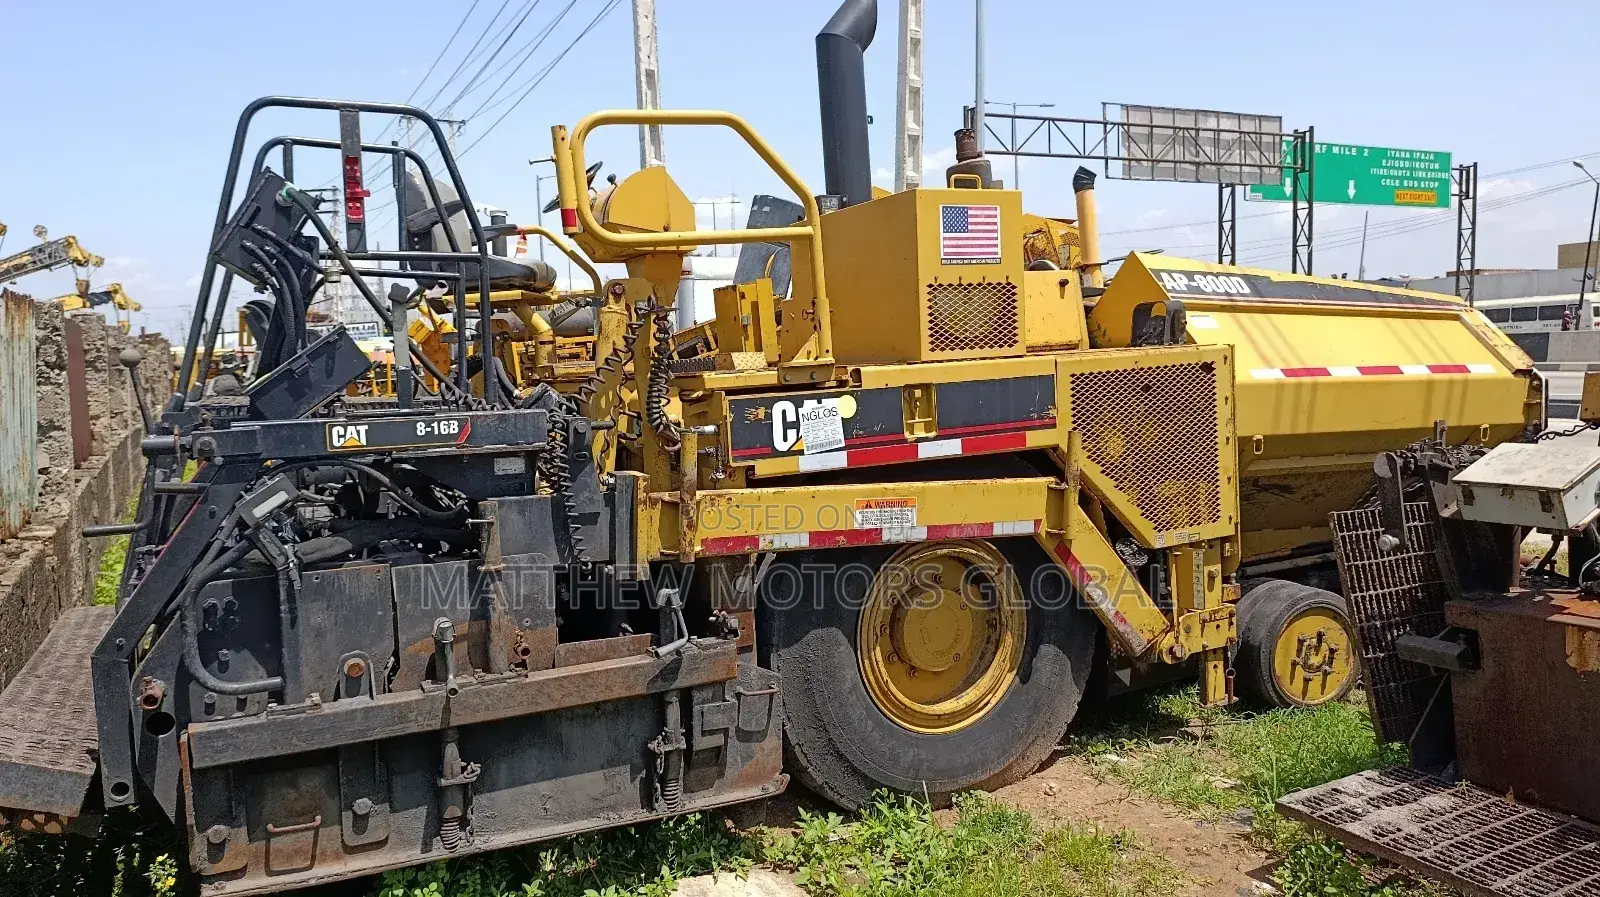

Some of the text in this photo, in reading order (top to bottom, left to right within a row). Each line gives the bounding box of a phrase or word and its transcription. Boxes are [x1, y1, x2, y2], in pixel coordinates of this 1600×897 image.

[1332, 145, 1357, 156] MILE
[1363, 148, 1370, 157] 2
[1387, 150, 1434, 160] IYANA IPAJA
[1381, 179, 1400, 187] CELE
[1420, 181, 1439, 189] STOP
[1160, 272, 1251, 294] AP-800D
[801, 406, 839, 422] NGLOS
[331, 420, 459, 447] CAT 8-16B
[874, 500, 908, 508] WARNING
